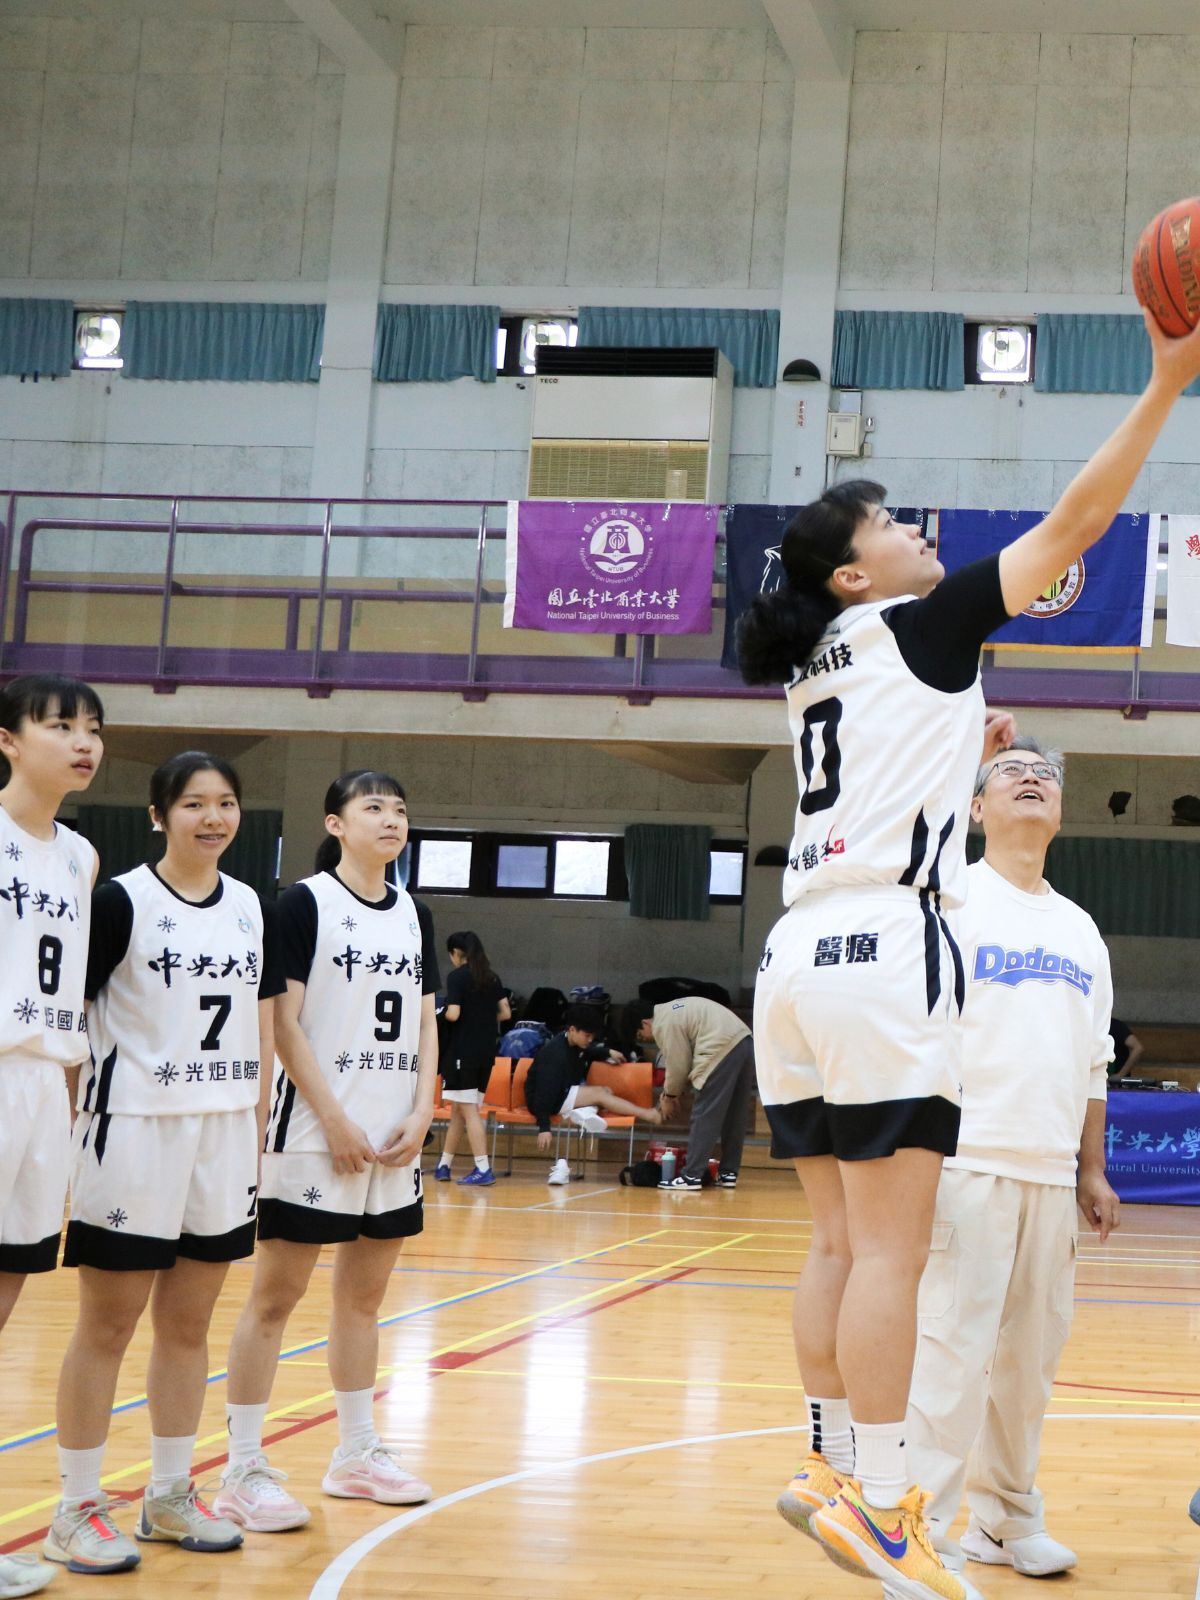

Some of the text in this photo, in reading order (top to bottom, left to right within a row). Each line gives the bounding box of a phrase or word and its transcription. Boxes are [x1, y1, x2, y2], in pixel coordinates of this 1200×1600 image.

[547, 611, 680, 621] National Taipei University of Business
[800, 696, 843, 816] 0
[0, 876, 80, 922] 中央大
[38, 934, 63, 996] 8
[970, 944, 1095, 998] Dodgers
[200, 995, 232, 1050] 7
[374, 990, 403, 1042] 9
[1107, 1163, 1136, 1172] ntral
